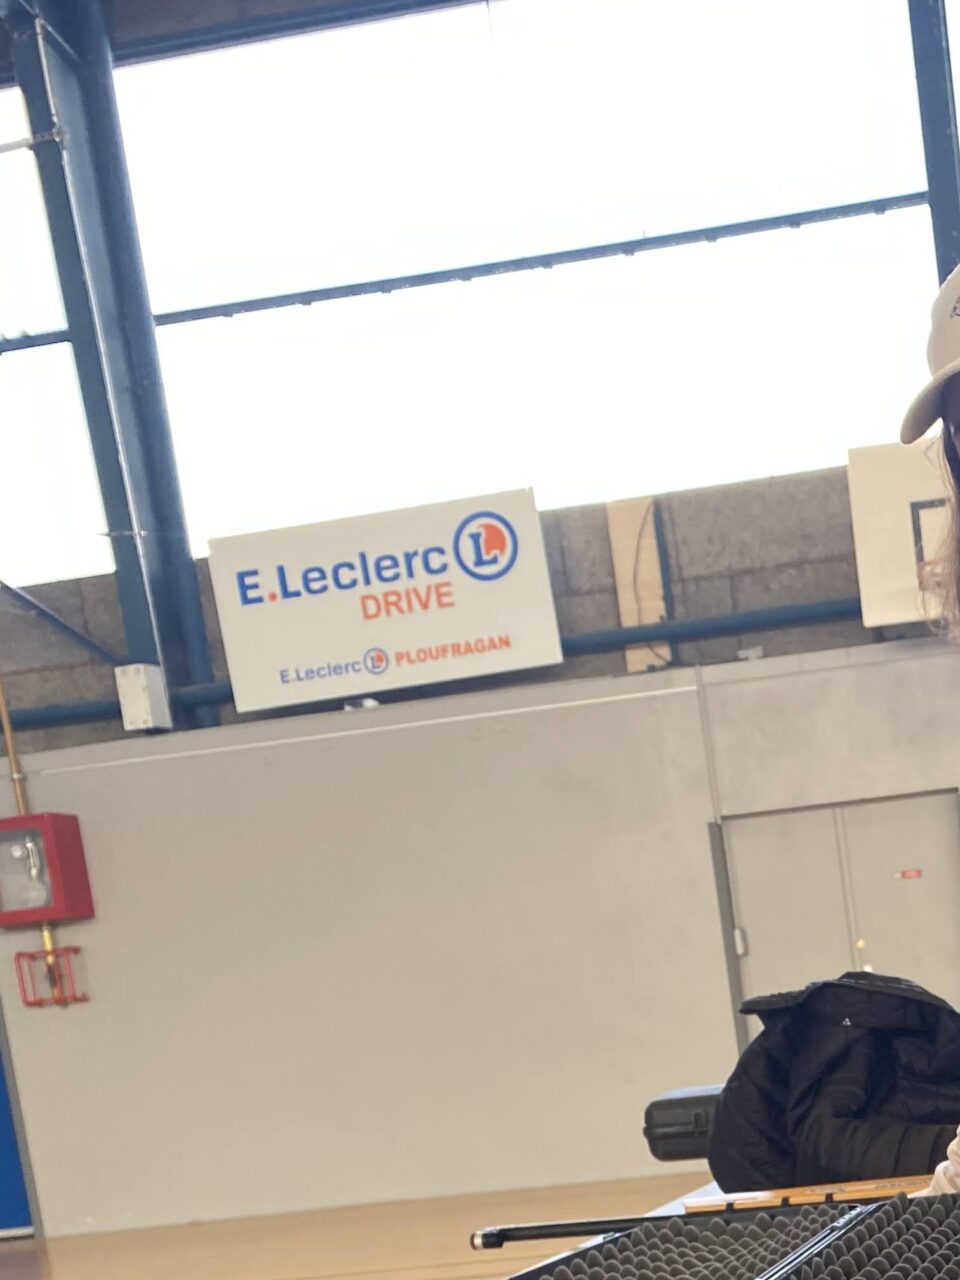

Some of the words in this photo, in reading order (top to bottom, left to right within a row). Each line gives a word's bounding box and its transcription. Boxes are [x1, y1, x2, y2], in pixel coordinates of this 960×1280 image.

[236, 545, 449, 606] E.Leclerc
[360, 581, 456, 620] DRIVE
[279, 659, 362, 684] E.Leclerc
[394, 635, 511, 667] PLOUFRAGAN
